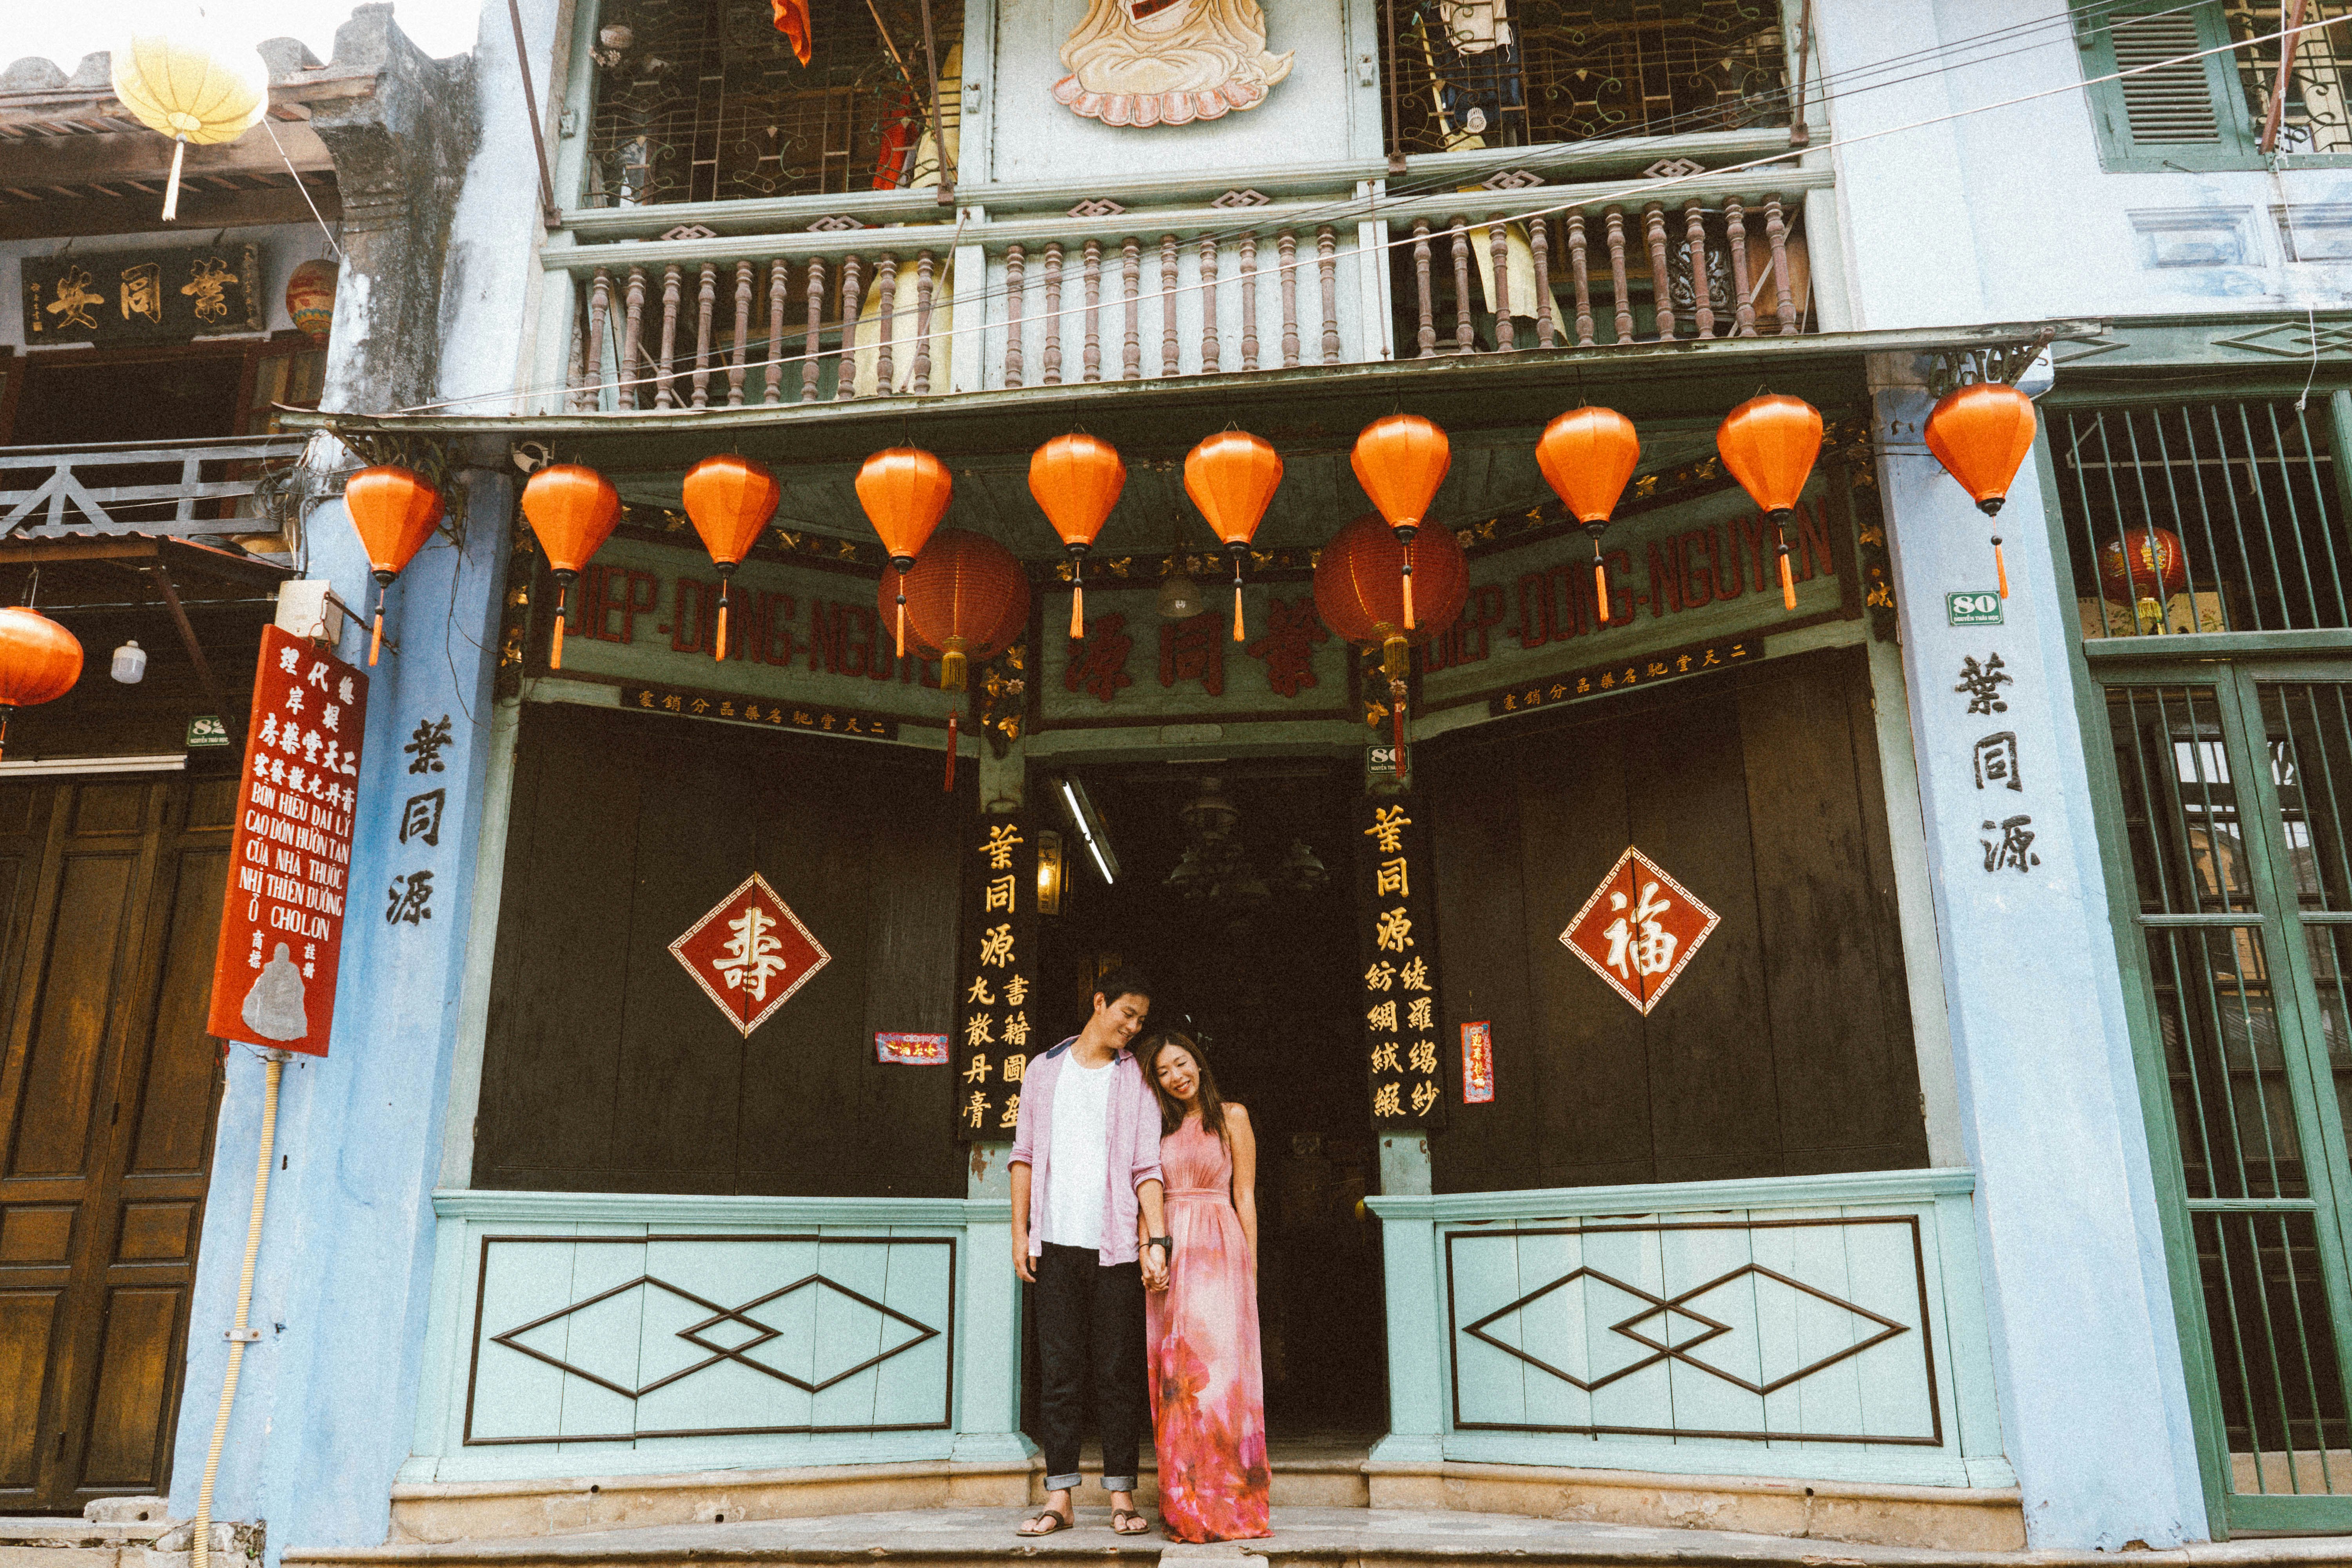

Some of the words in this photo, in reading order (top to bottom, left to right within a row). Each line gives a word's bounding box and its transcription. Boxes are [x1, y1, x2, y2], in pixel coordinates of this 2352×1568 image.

[1953, 595, 1996, 613] 80
[192, 720, 226, 735] 82
[1955, 652, 2040, 873] 葉同源
[245, 809, 269, 835] CAO
[275, 848, 301, 877] NHÀ
[387, 714, 453, 926] 葉同源
[978, 824, 1024, 968] 葉同源
[1364, 805, 1414, 953] 葉同源
[713, 906, 786, 1001] 壽
[1604, 882, 1678, 980] 福
